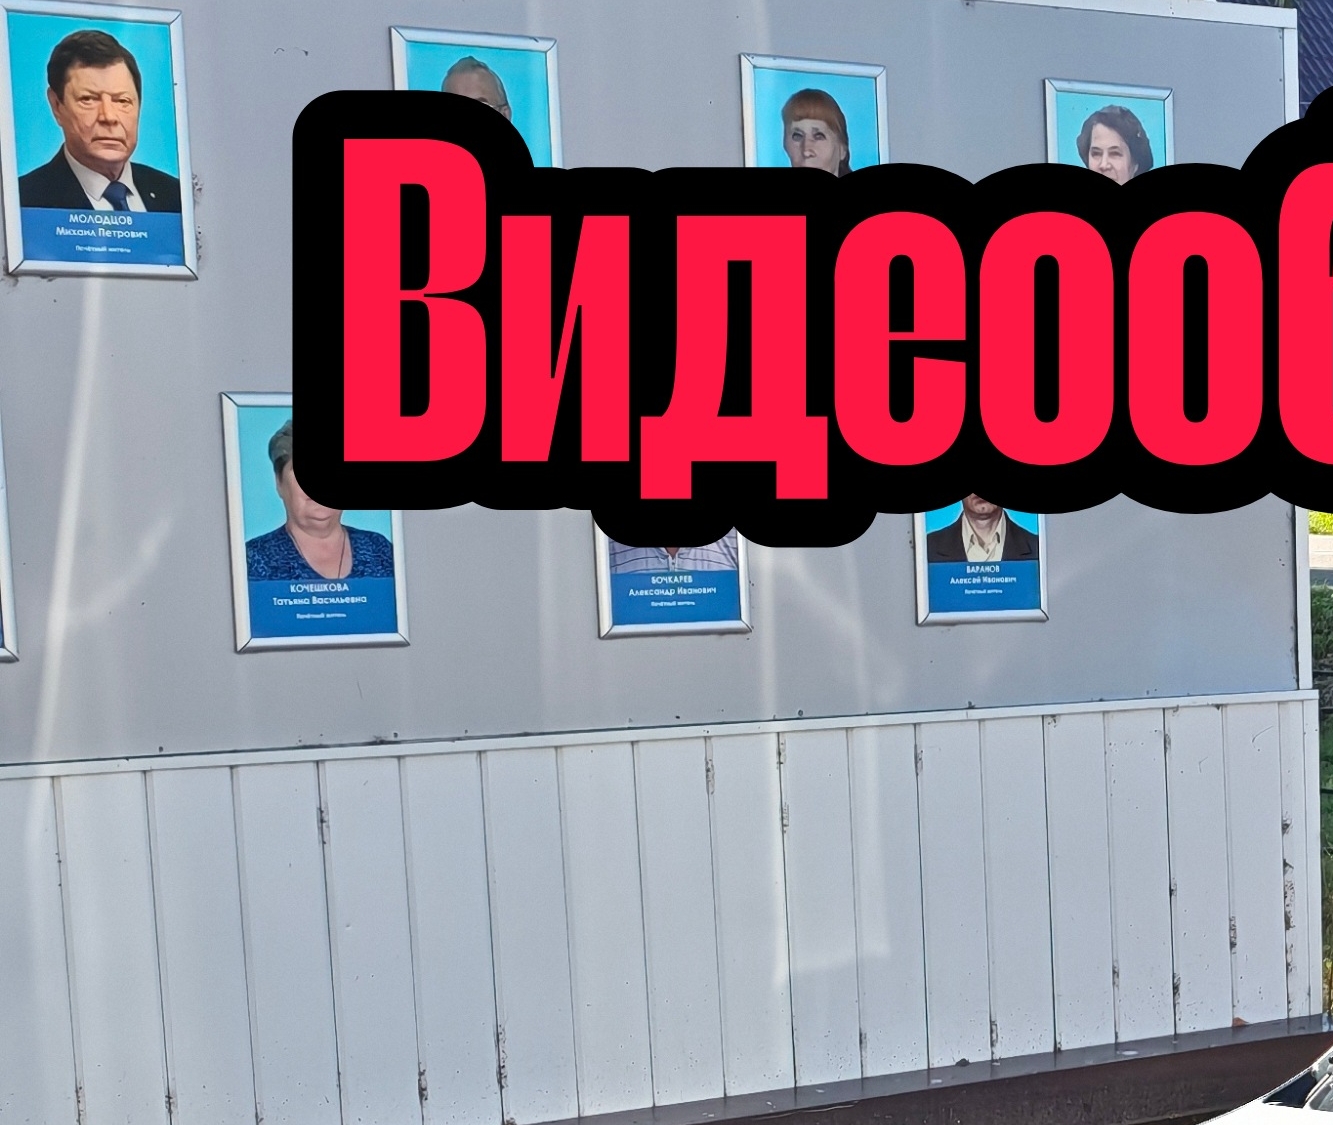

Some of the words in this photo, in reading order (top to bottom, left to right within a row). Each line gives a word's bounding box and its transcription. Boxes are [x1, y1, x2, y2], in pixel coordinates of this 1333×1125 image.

[69, 213, 133, 226] МОЛОДЦОВ
[56, 226, 97, 237] Михаил
[98, 228, 149, 239] Петрович
[290, 583, 350, 593] КОЧЕШКОВА
[629, 587, 675, 597] Александр
[677, 586, 717, 595] Иванович
[272, 597, 311, 606] Татьяна
[311, 596, 367, 605] Васильевна
